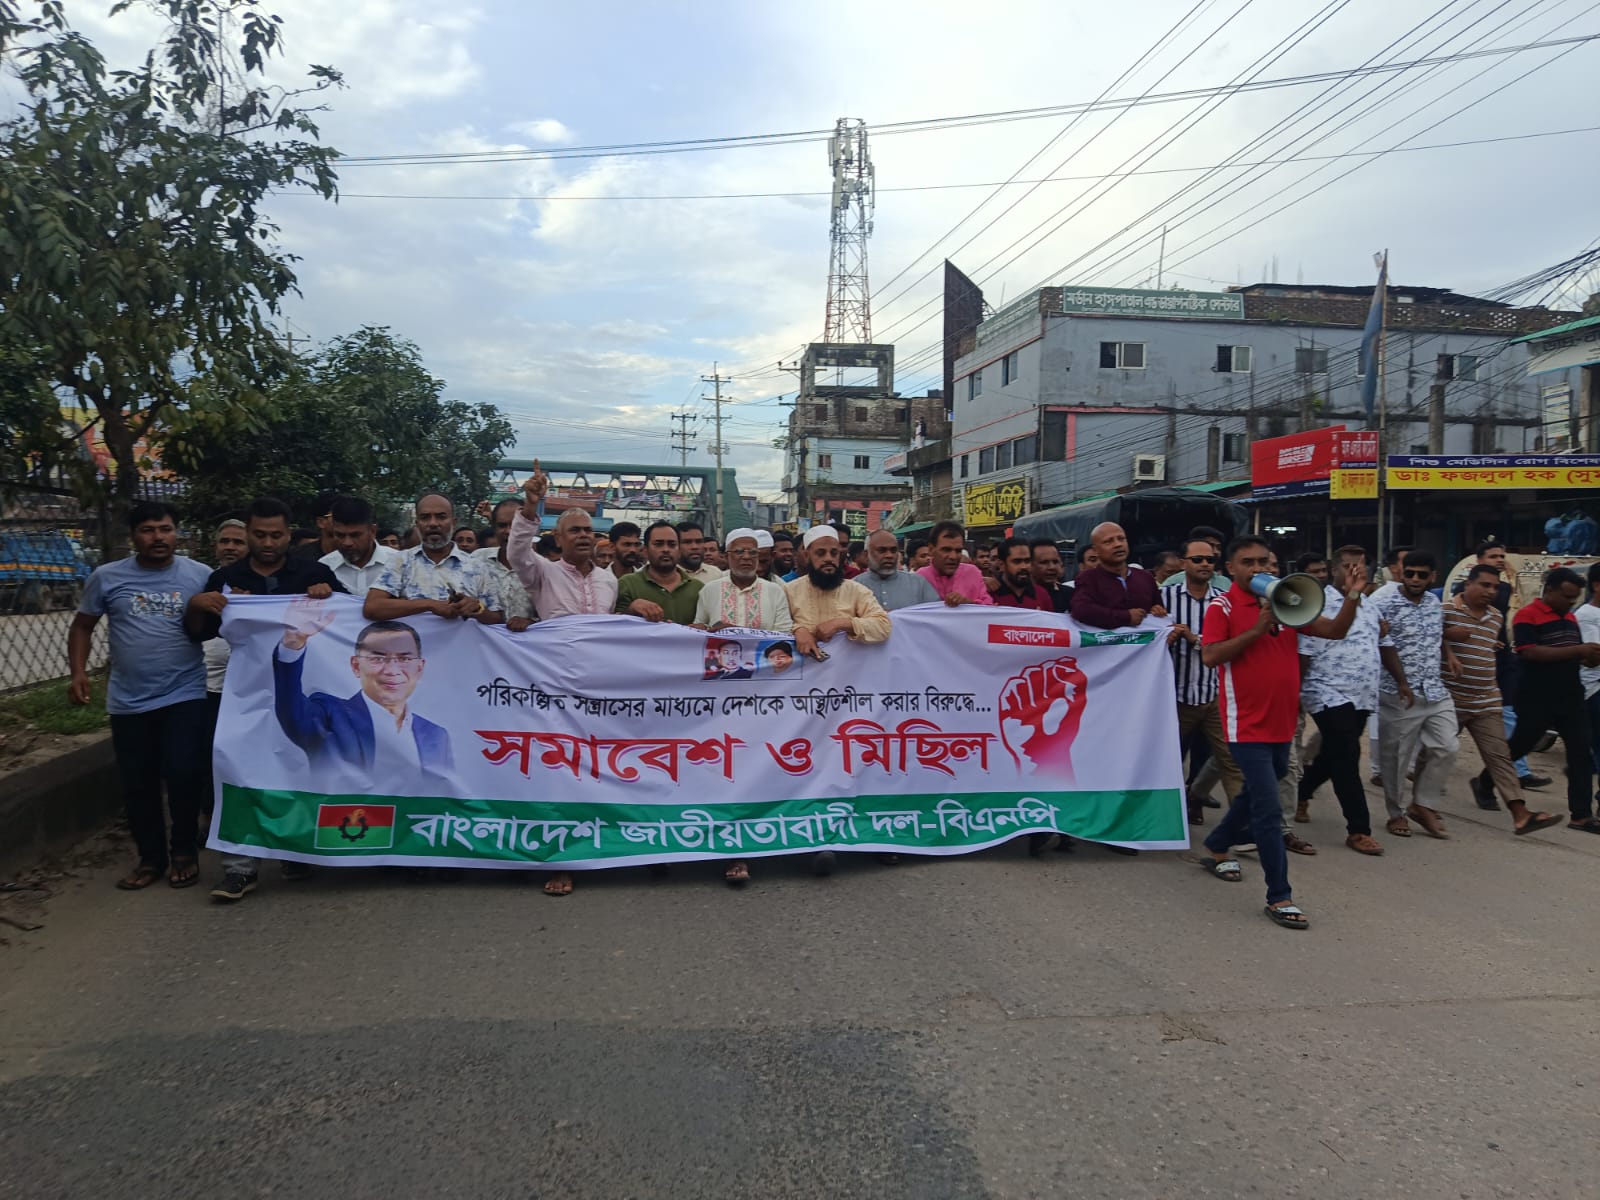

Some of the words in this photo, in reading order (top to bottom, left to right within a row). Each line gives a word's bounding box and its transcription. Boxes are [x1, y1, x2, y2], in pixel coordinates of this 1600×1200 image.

[1409, 457, 1440, 466] শিশু
[1446, 457, 1510, 466] মেডিসিন
[1514, 457, 1550, 466] রোগ
[1553, 456, 1600, 465] বিশেষ
[1438, 470, 1516, 484] ফজলুল
[1523, 470, 1560, 482] হক
[1003, 629, 1056, 644] বাংলাদেশ
[476, 677, 568, 711] পরিকল্পিত
[571, 694, 649, 717] সন্ত্রাসের
[652, 696, 715, 719] মাধ্যমে
[721, 695, 785, 717] দেশকে
[790, 686, 875, 719] অস্থিতিশীল
[879, 691, 921, 713] করার
[474, 730, 748, 786] সমাবেশ
[765, 737, 814, 777] ও
[831, 719, 999, 778] মিছিল
[407, 812, 609, 851] বাংলাদেশ
[617, 804, 859, 850] জাতীয়তাবাদী
